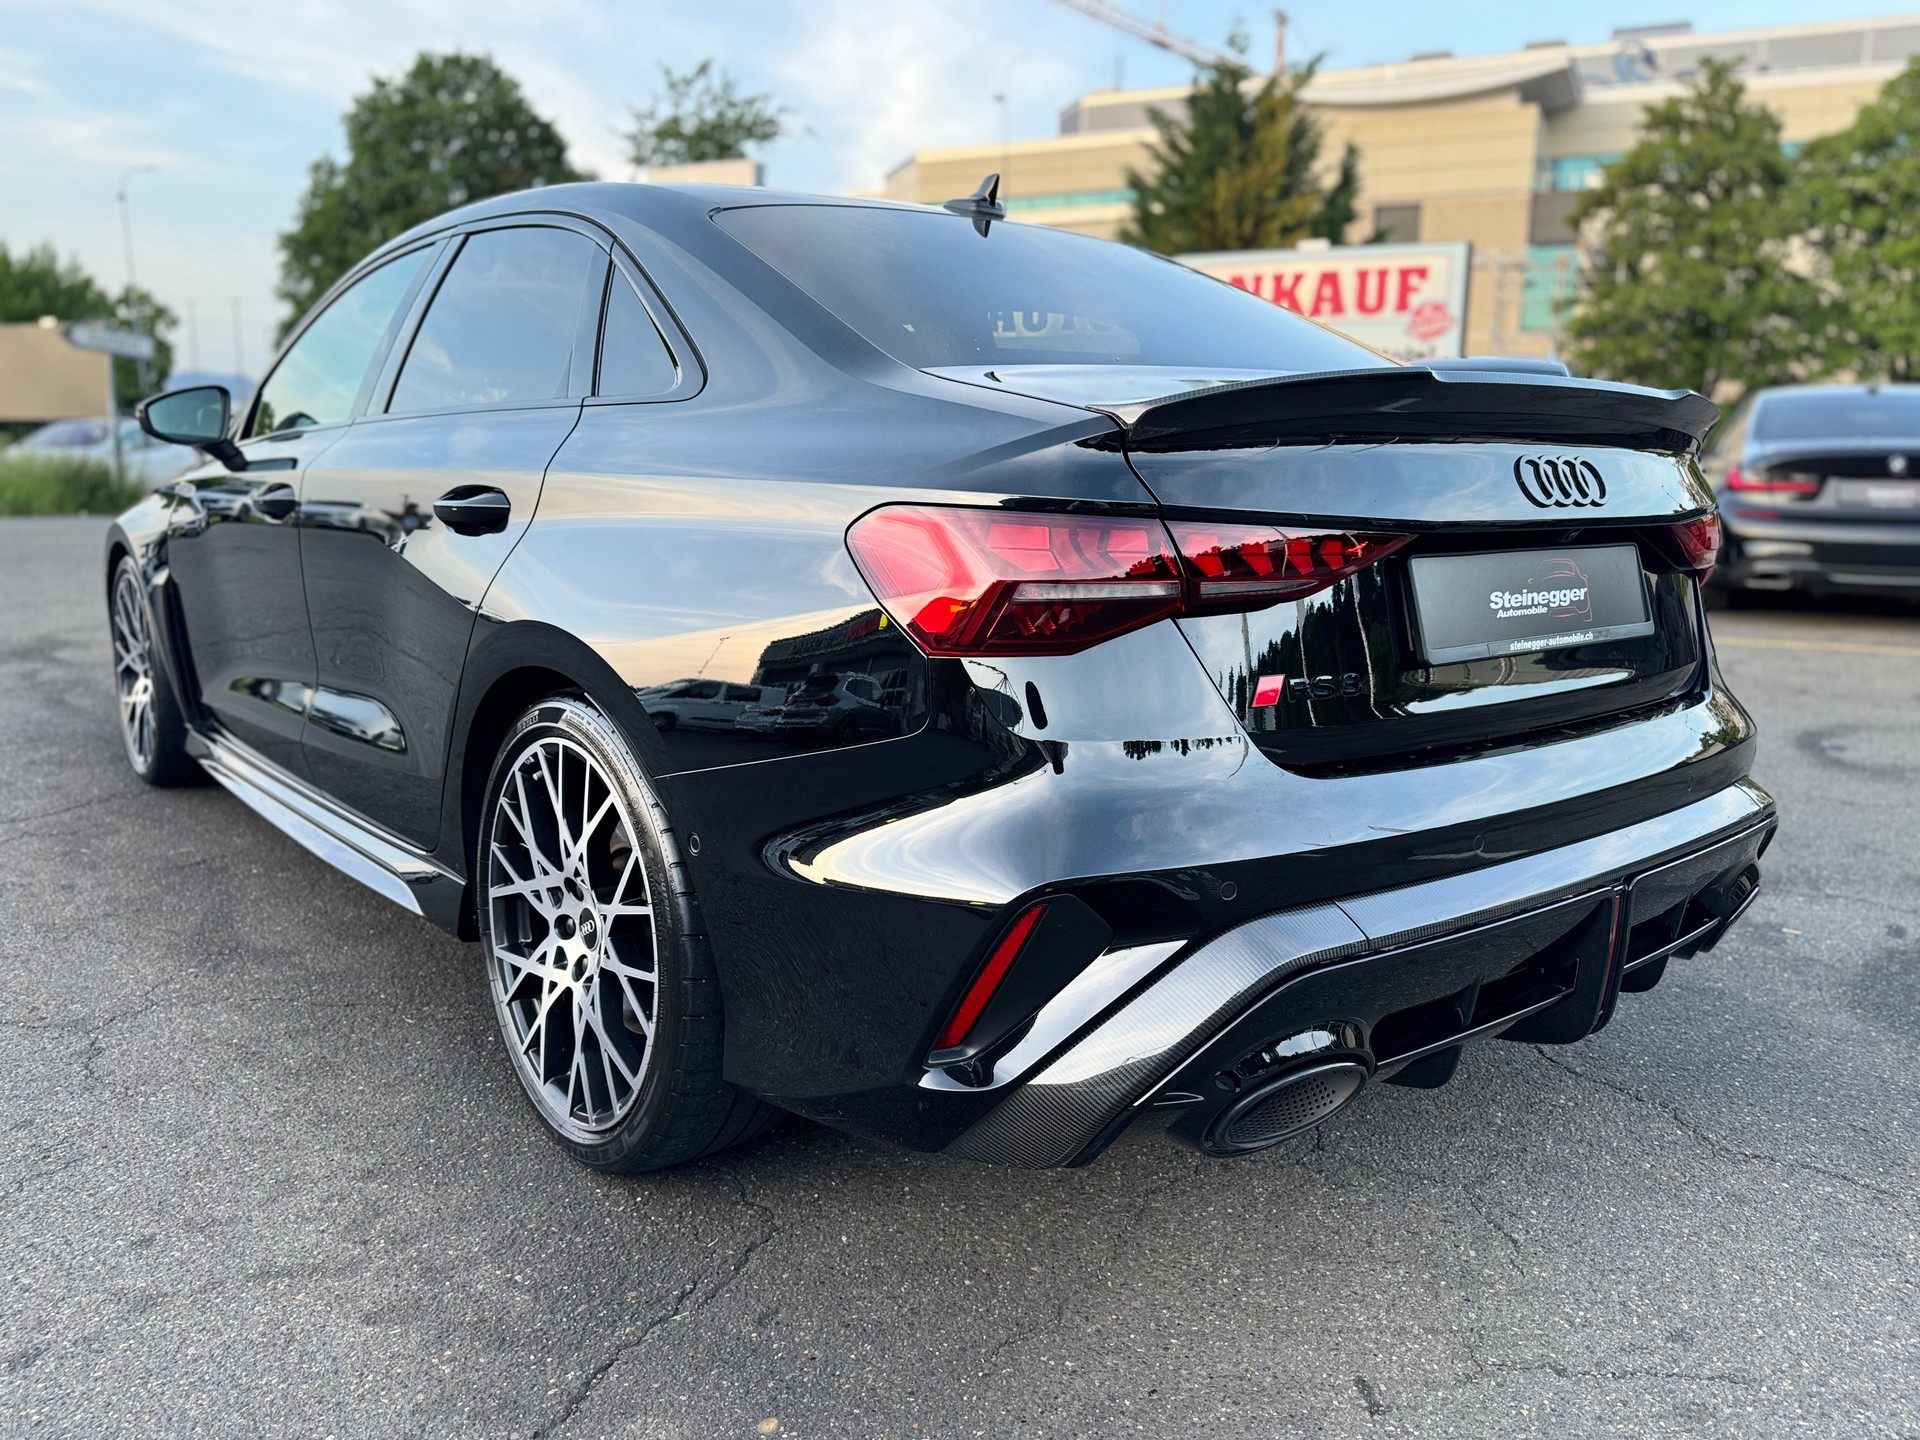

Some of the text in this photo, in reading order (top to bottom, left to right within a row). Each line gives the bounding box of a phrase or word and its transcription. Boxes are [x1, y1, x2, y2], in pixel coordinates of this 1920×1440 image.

[1489, 585, 1588, 610] Steinegger
[1496, 605, 1548, 619] Automobile
[1509, 631, 1594, 651] steinegger-automobile.ch
[1286, 676, 1335, 702] RS
